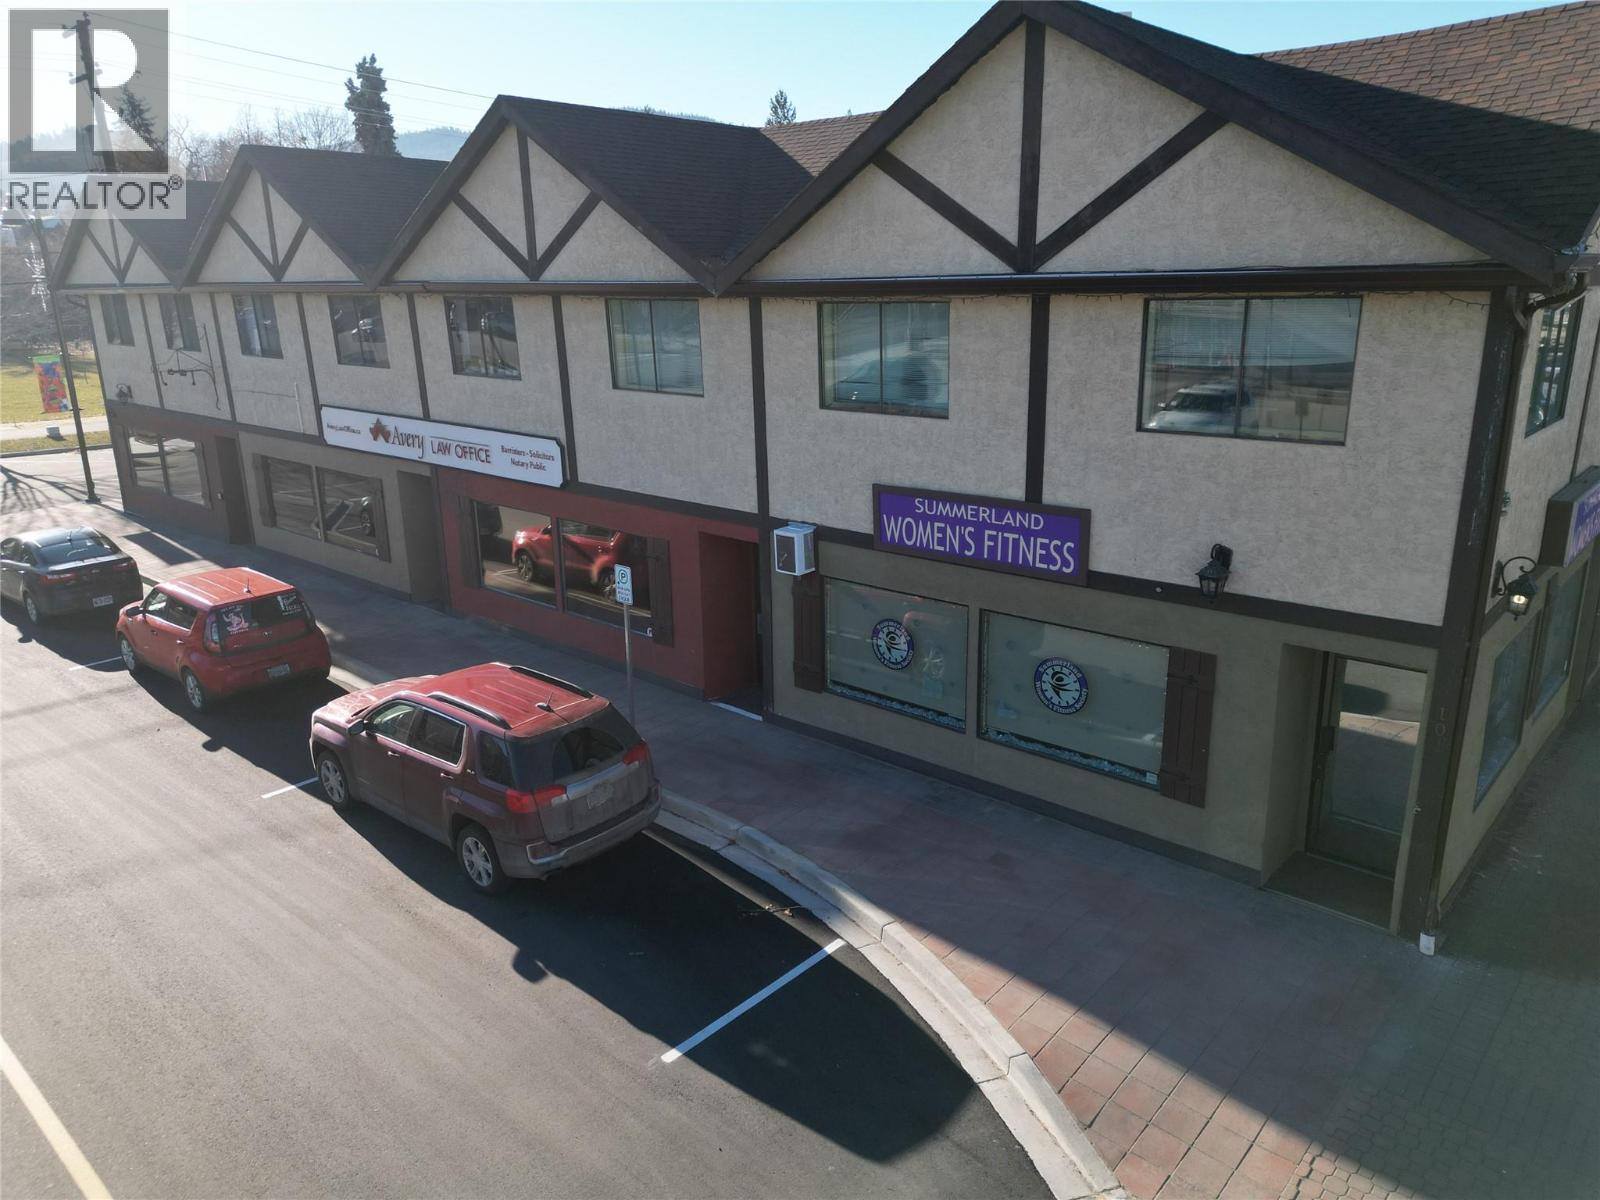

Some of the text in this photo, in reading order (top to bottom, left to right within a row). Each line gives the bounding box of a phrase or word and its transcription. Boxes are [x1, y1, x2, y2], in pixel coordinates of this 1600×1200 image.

[392, 425, 424, 459] Avery
[431, 440, 492, 464] LAW OFFICE
[501, 444, 555, 461] Barristers Solicitors
[510, 457, 547, 471] Notary Public
[914, 498, 1044, 530] SUMMERLAND
[883, 514, 1075, 574] WOMEN'S FITNESS
[1037, 657, 1083, 679] Summerland
